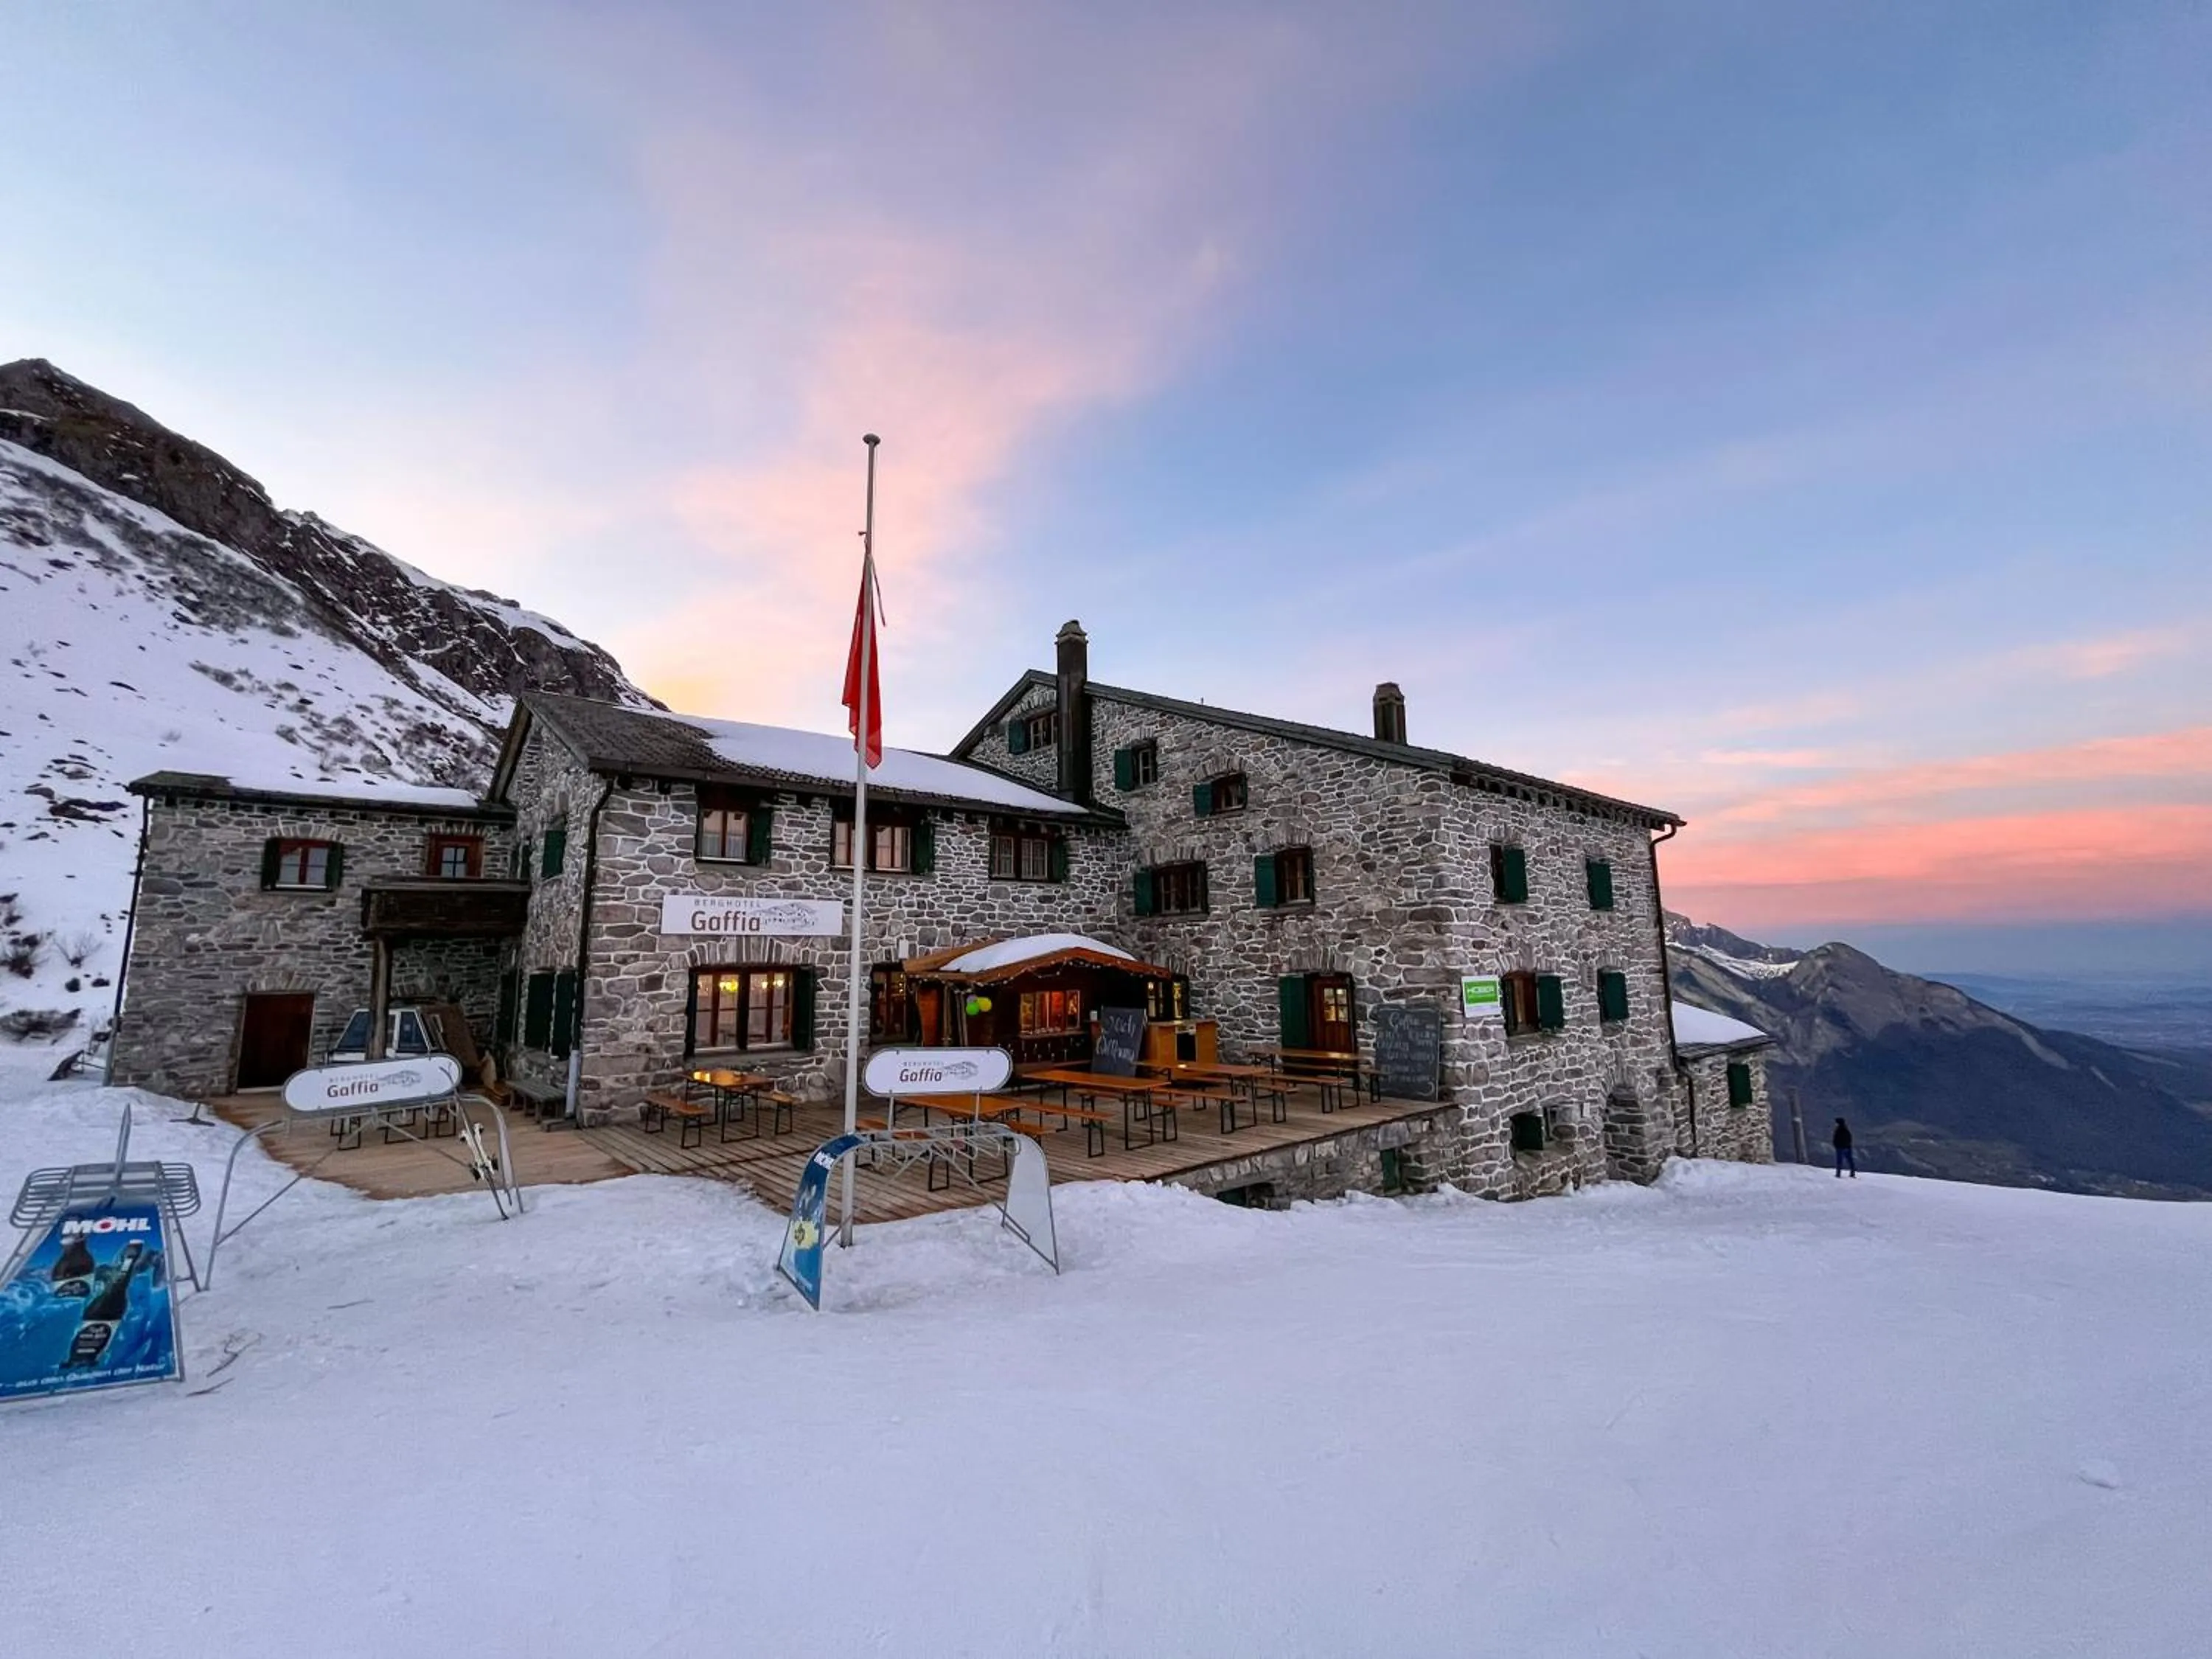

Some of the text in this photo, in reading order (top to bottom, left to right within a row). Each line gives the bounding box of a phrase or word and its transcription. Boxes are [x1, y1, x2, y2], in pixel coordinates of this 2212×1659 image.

[694, 899, 761, 908] BERGHOTEL
[691, 911, 761, 932] Gaffia
[899, 1068, 943, 1082] Gaffia
[327, 1081, 379, 1098] Gaffia
